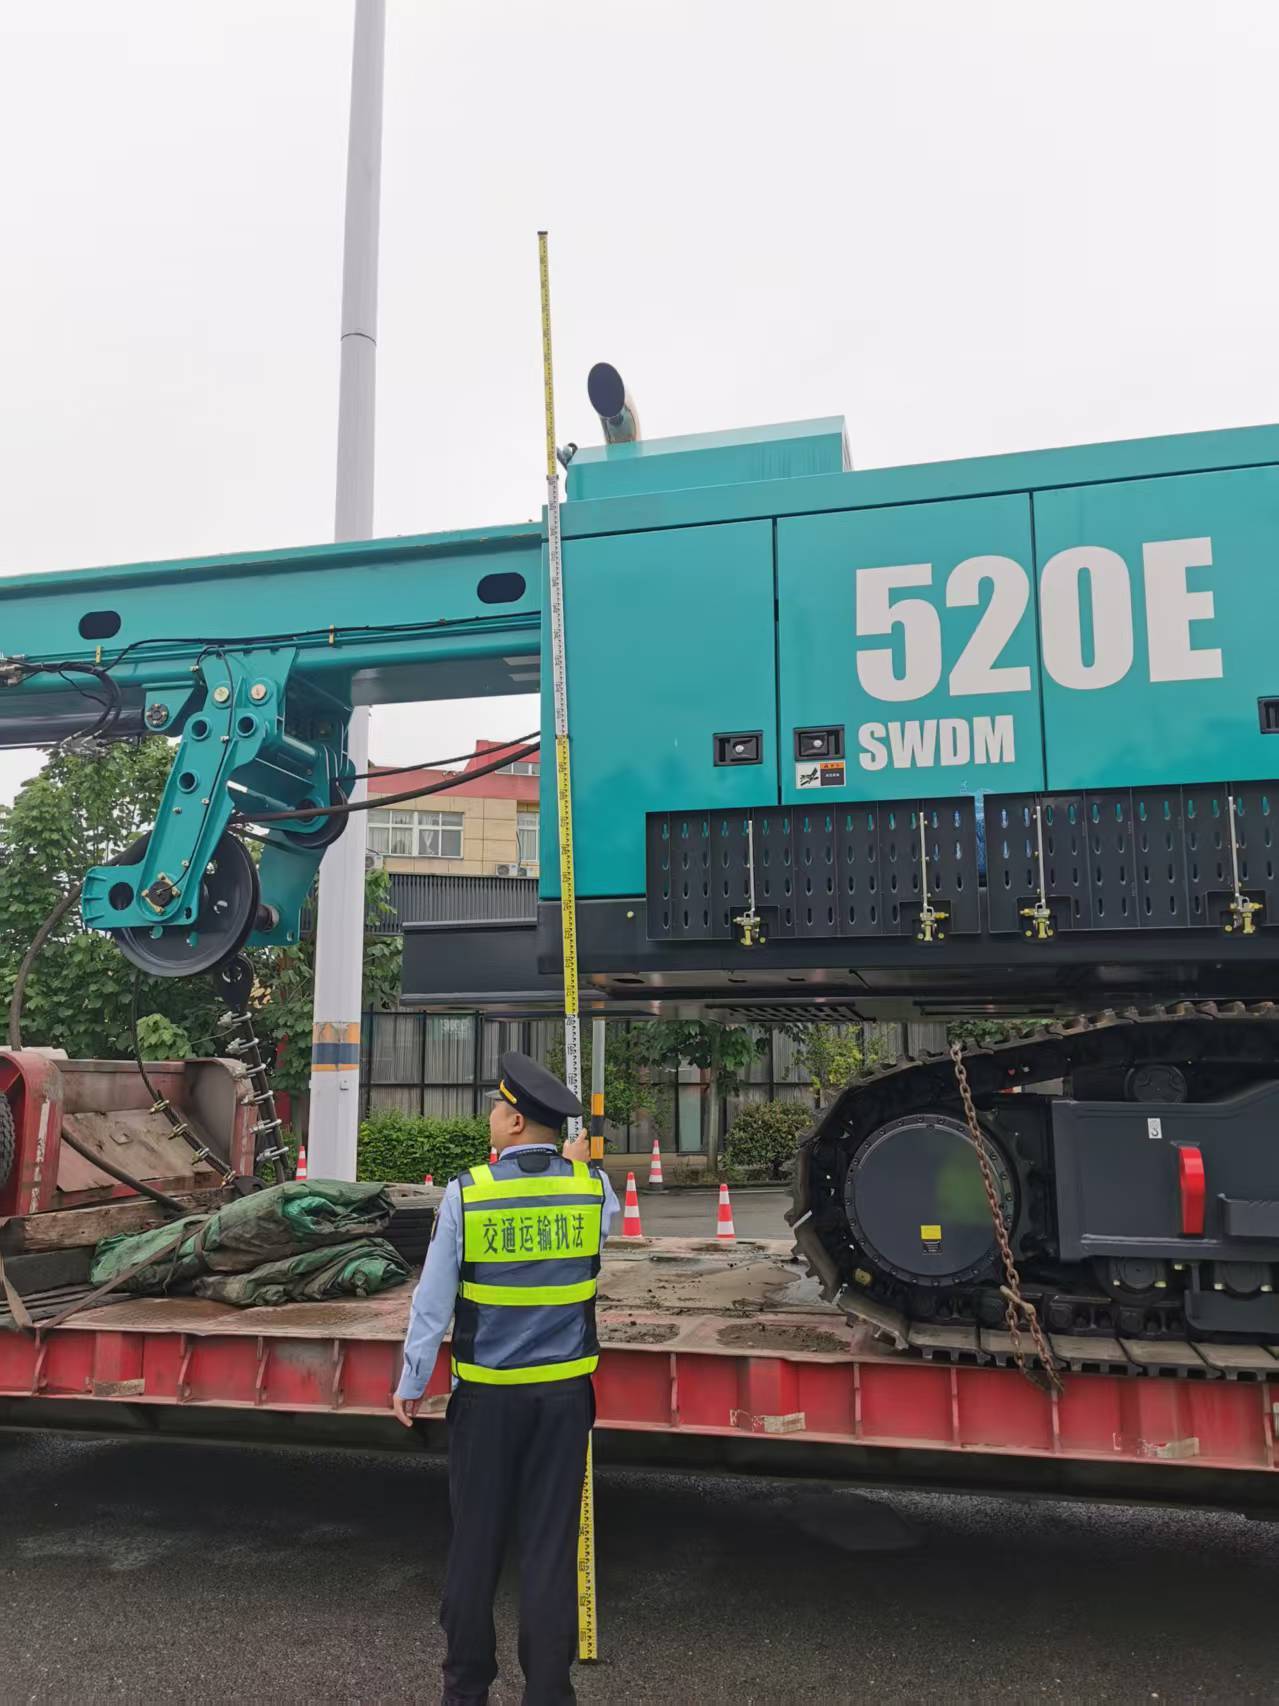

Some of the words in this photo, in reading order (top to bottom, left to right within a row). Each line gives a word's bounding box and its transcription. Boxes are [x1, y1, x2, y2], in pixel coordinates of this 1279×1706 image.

[856, 536, 1224, 702] 520E
[858, 715, 1015, 771] SWDM
[483, 1214, 584, 1254] 交通运输执法
